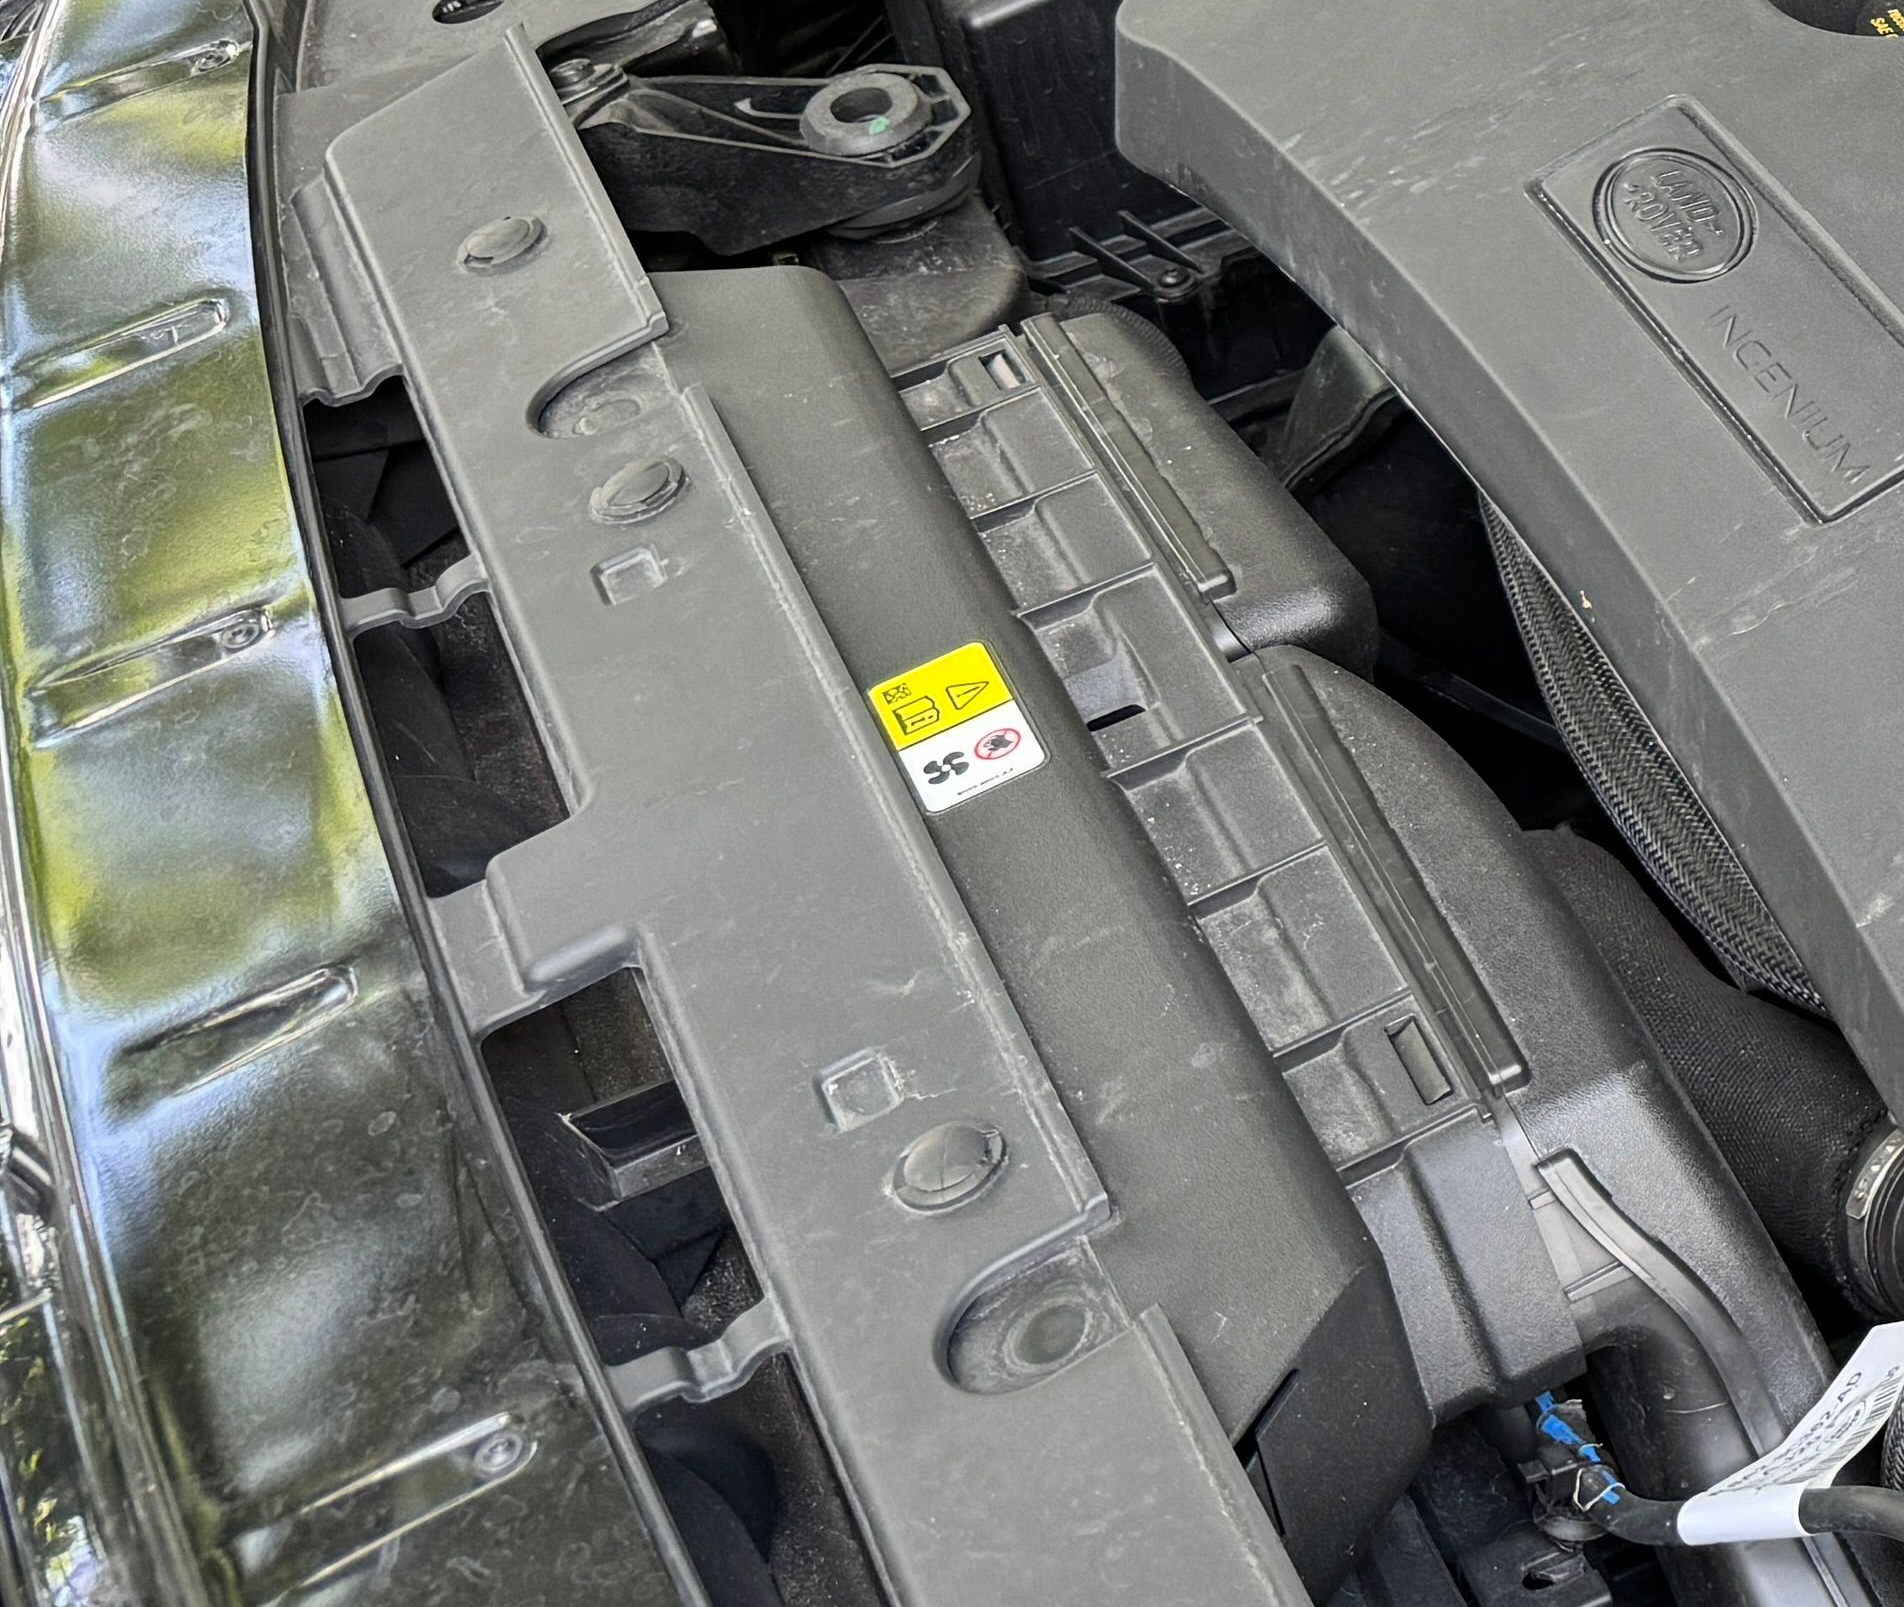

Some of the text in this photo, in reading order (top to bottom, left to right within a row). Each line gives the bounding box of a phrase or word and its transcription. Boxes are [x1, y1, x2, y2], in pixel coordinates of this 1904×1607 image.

[1628, 188, 1703, 262] ROVER
[1651, 169, 1722, 232] LAND
[1708, 304, 1872, 484] INGENIUM
